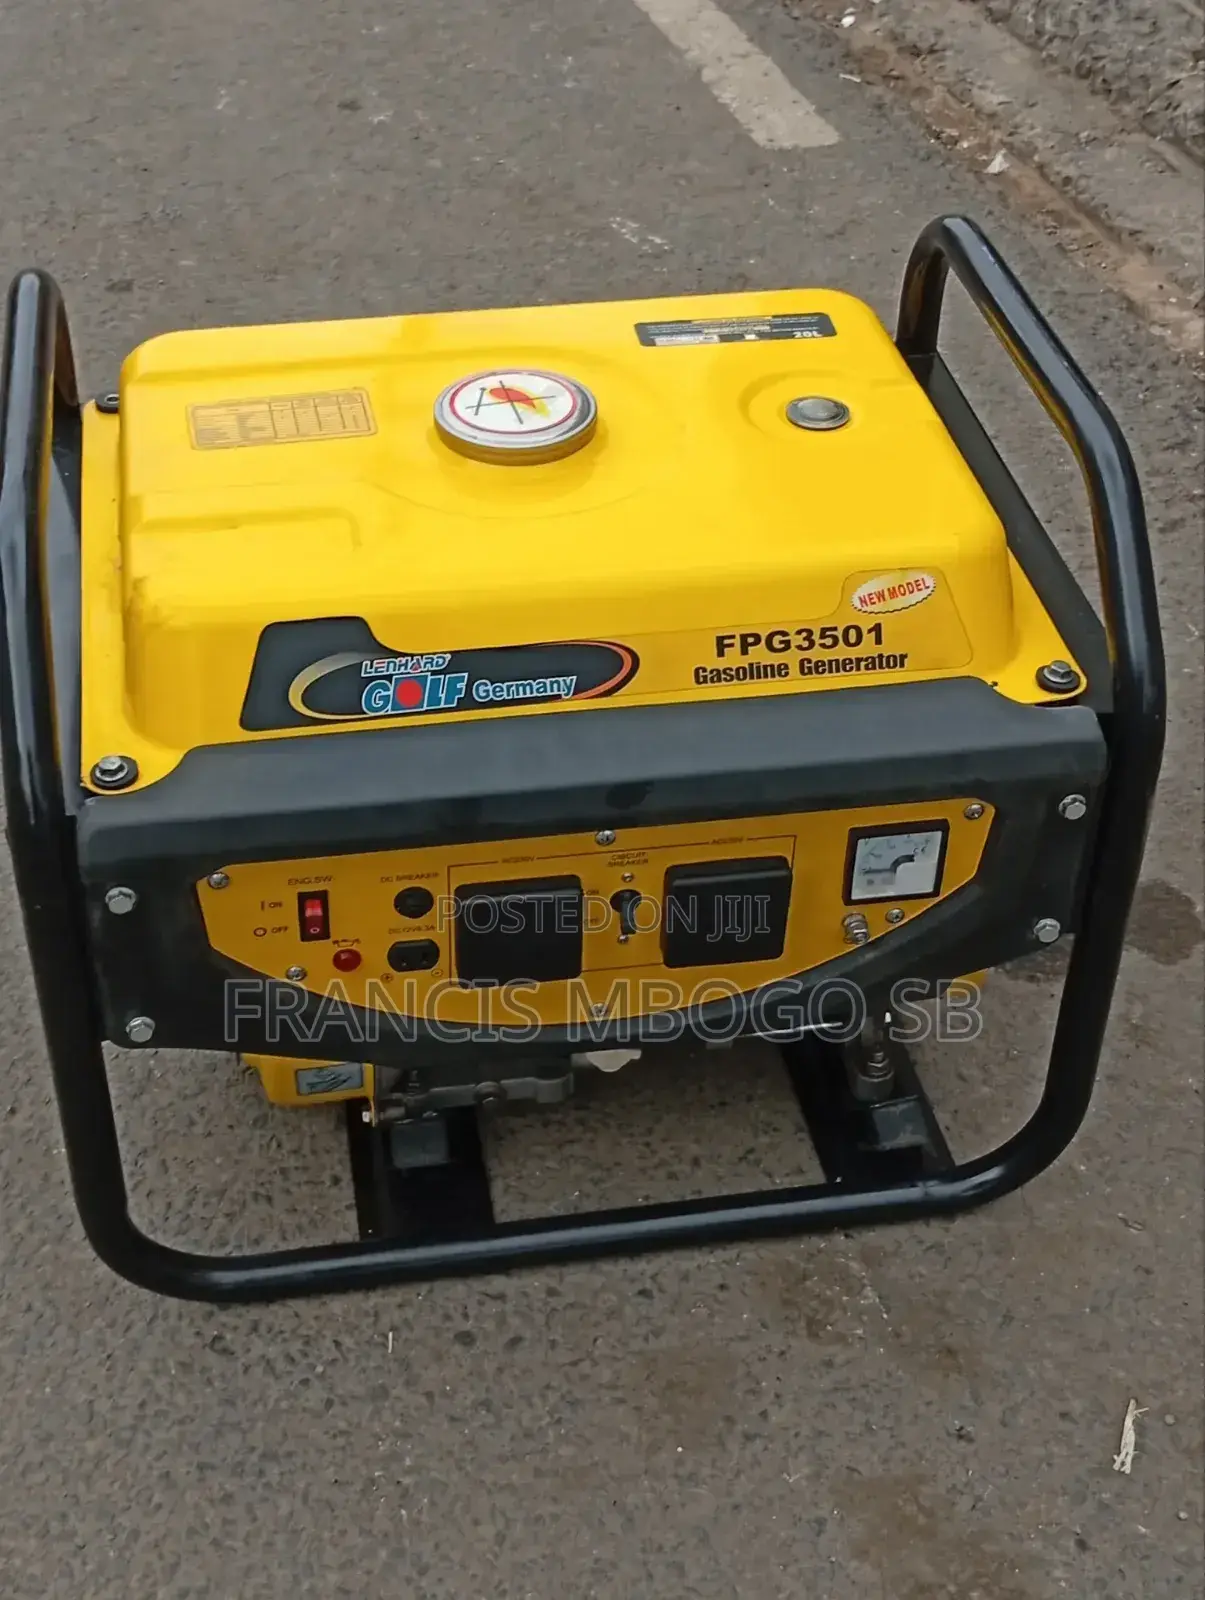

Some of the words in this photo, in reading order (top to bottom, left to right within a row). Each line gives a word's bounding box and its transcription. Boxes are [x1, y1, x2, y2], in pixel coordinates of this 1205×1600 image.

[858, 588, 887, 608] NEW
[888, 577, 931, 600] MODEL
[714, 622, 884, 658] FPG3501
[360, 654, 451, 677] LENHARD
[693, 660, 790, 685] Gasoline
[798, 652, 908, 677] Generator
[472, 675, 577, 703] Germany
